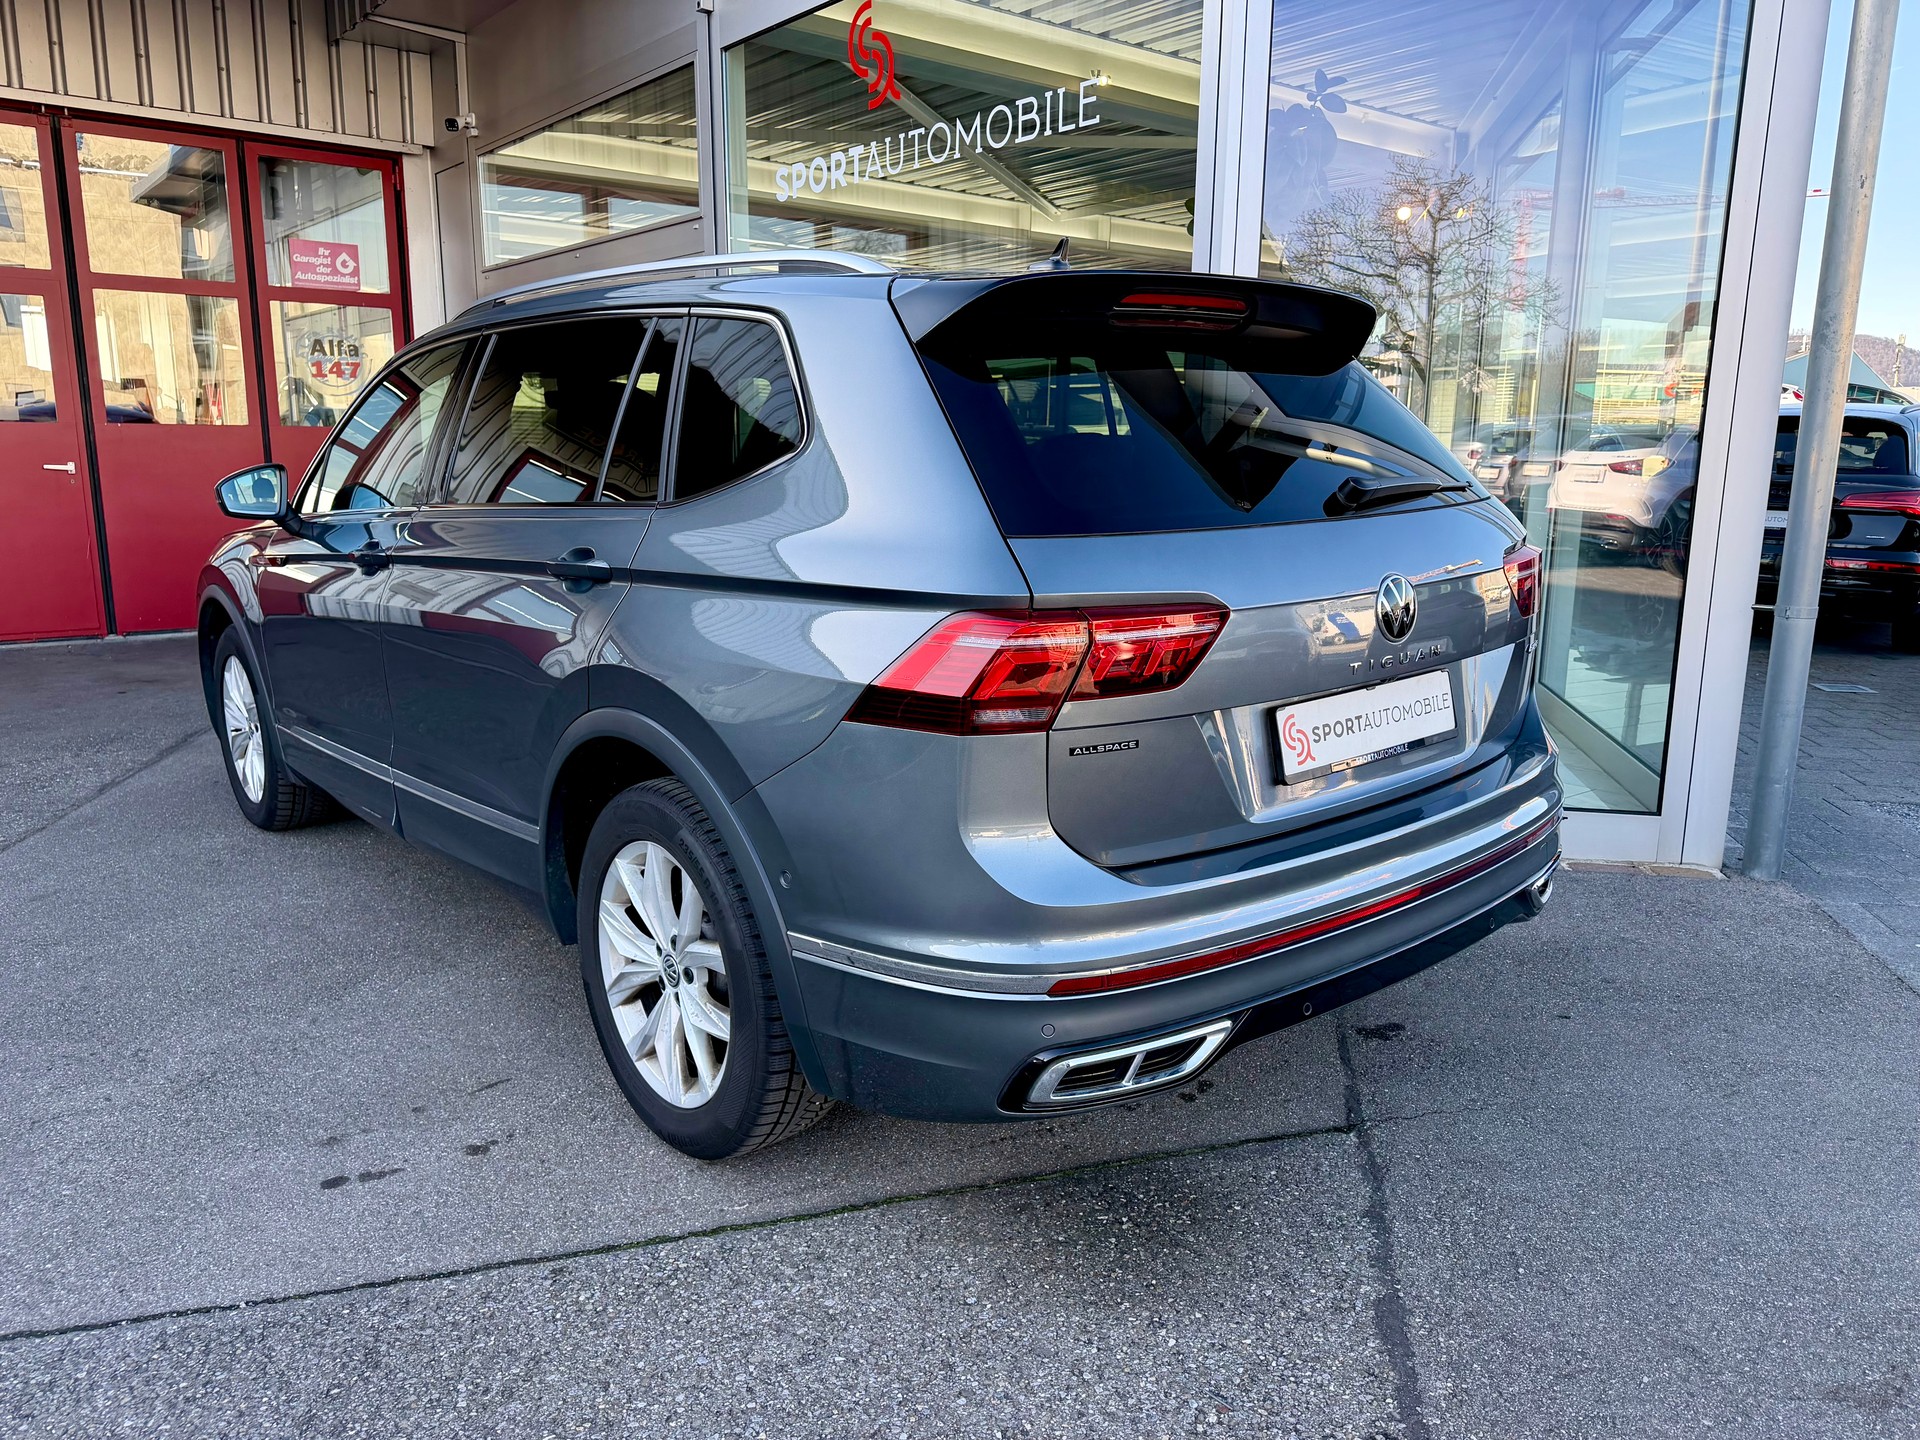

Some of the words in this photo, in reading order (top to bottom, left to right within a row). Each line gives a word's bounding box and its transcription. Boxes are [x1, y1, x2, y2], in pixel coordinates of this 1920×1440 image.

[775, 78, 1100, 202] SPORTAUTOMOBILE
[293, 253, 331, 265] Garagist
[318, 247, 331, 256] Ihr
[295, 271, 358, 283] Autospezialist
[316, 265, 332, 274] der
[310, 339, 359, 357] Alfa
[311, 360, 361, 379] 147
[1349, 644, 1441, 675] TIGUAN
[1311, 692, 1451, 744] SPORTAUTOMOBILE
[1073, 741, 1137, 755] ALLSPACE
